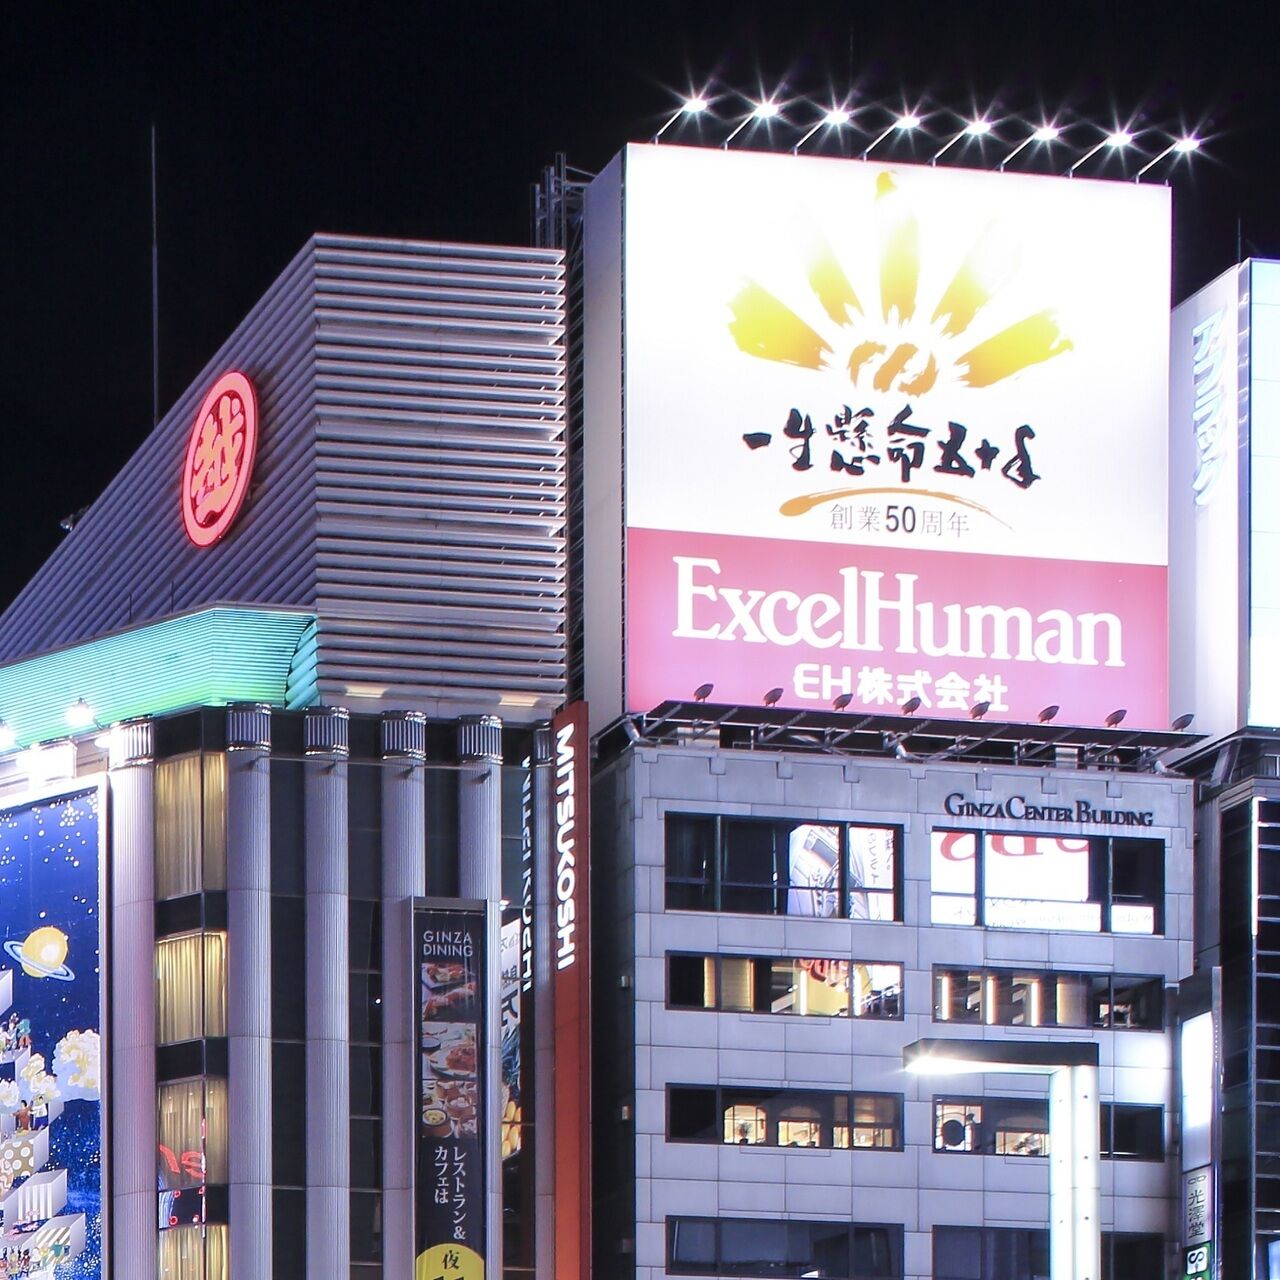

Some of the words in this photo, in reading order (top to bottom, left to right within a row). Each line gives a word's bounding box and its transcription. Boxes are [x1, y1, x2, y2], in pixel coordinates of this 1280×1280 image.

[829, 501, 971, 539] 創業50周年
[671, 554, 1126, 669] ExcelHuman
[793, 663, 1010, 712] EH株式会社
[943, 792, 1006, 820] GINZA
[1005, 795, 1074, 825] CENTER
[1076, 799, 1154, 828] BUILDING
[555, 722, 576, 972] MITSUKOSHI
[422, 943, 474, 958] DINING
[423, 930, 473, 945] GINZA
[434, 1145, 449, 1205] カフェは
[1188, 1188, 1205, 1239] 光澤堂
[441, 1249, 459, 1271] 夜
